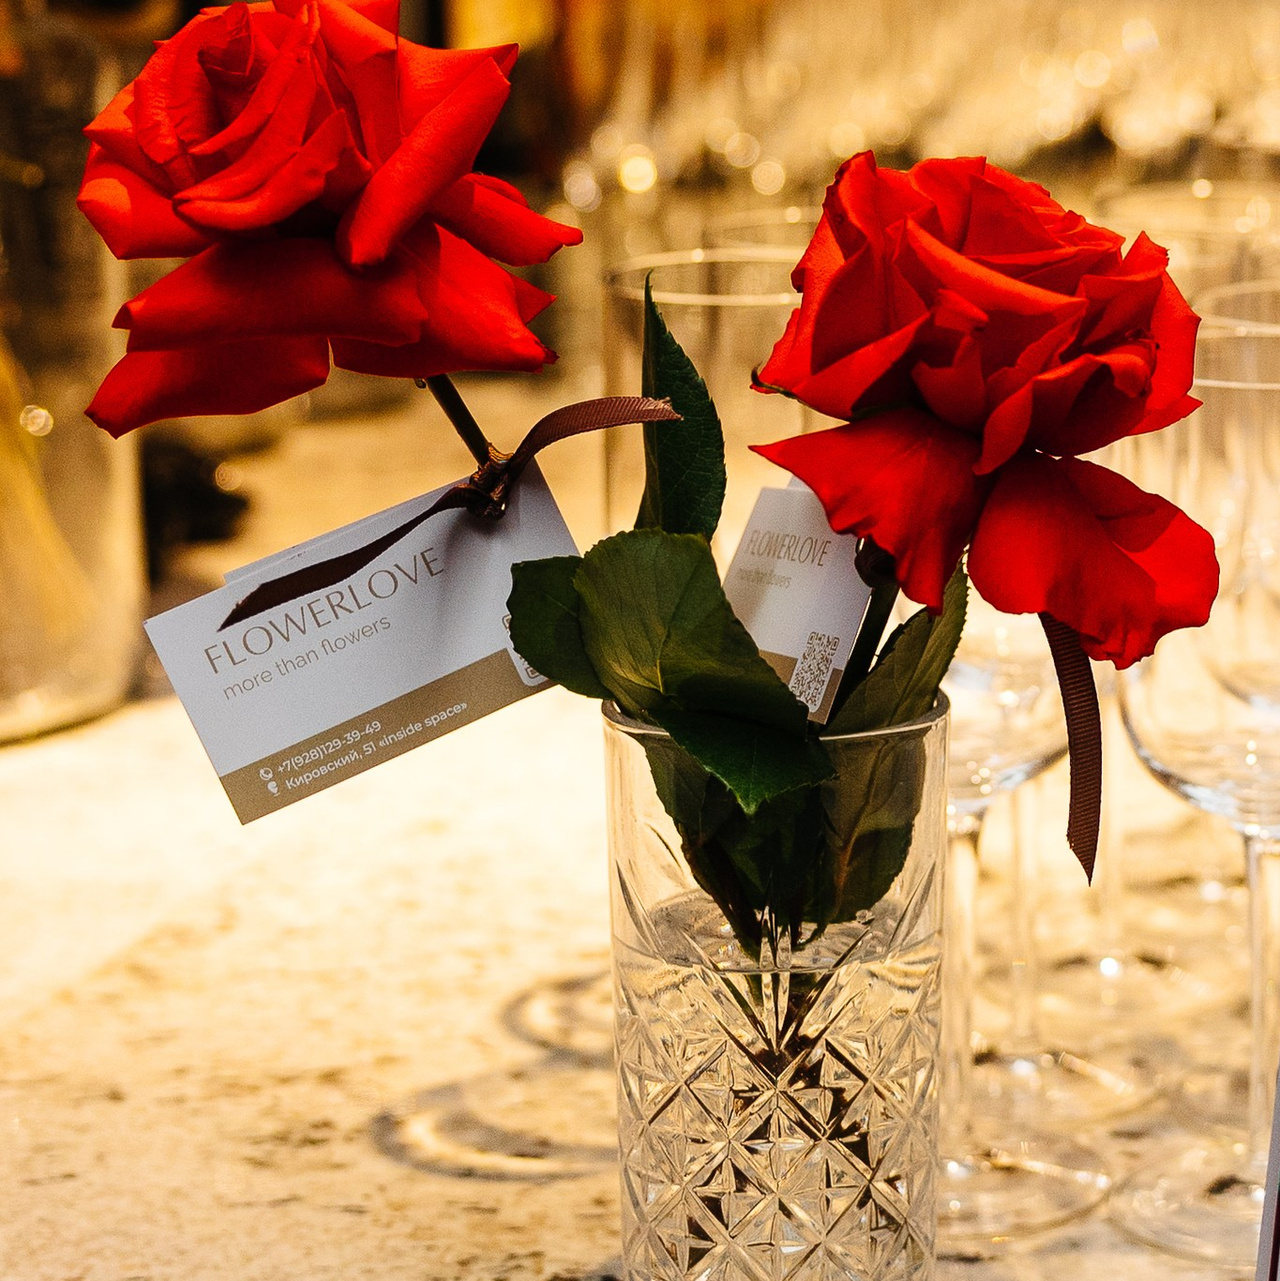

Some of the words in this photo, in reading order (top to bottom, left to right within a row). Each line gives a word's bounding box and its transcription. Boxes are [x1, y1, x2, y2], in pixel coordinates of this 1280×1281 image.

[204, 547, 445, 674] FLOWERLOVE
[223, 669, 274, 700] more
[275, 649, 320, 677] than
[321, 616, 392, 656] flowers
[277, 720, 382, 774] +7(928)129-39-49
[285, 748, 364, 790] Кировский,
[362, 742, 377, 756] 51
[378, 722, 423, 749] «inside
[424, 702, 468, 727] space»
